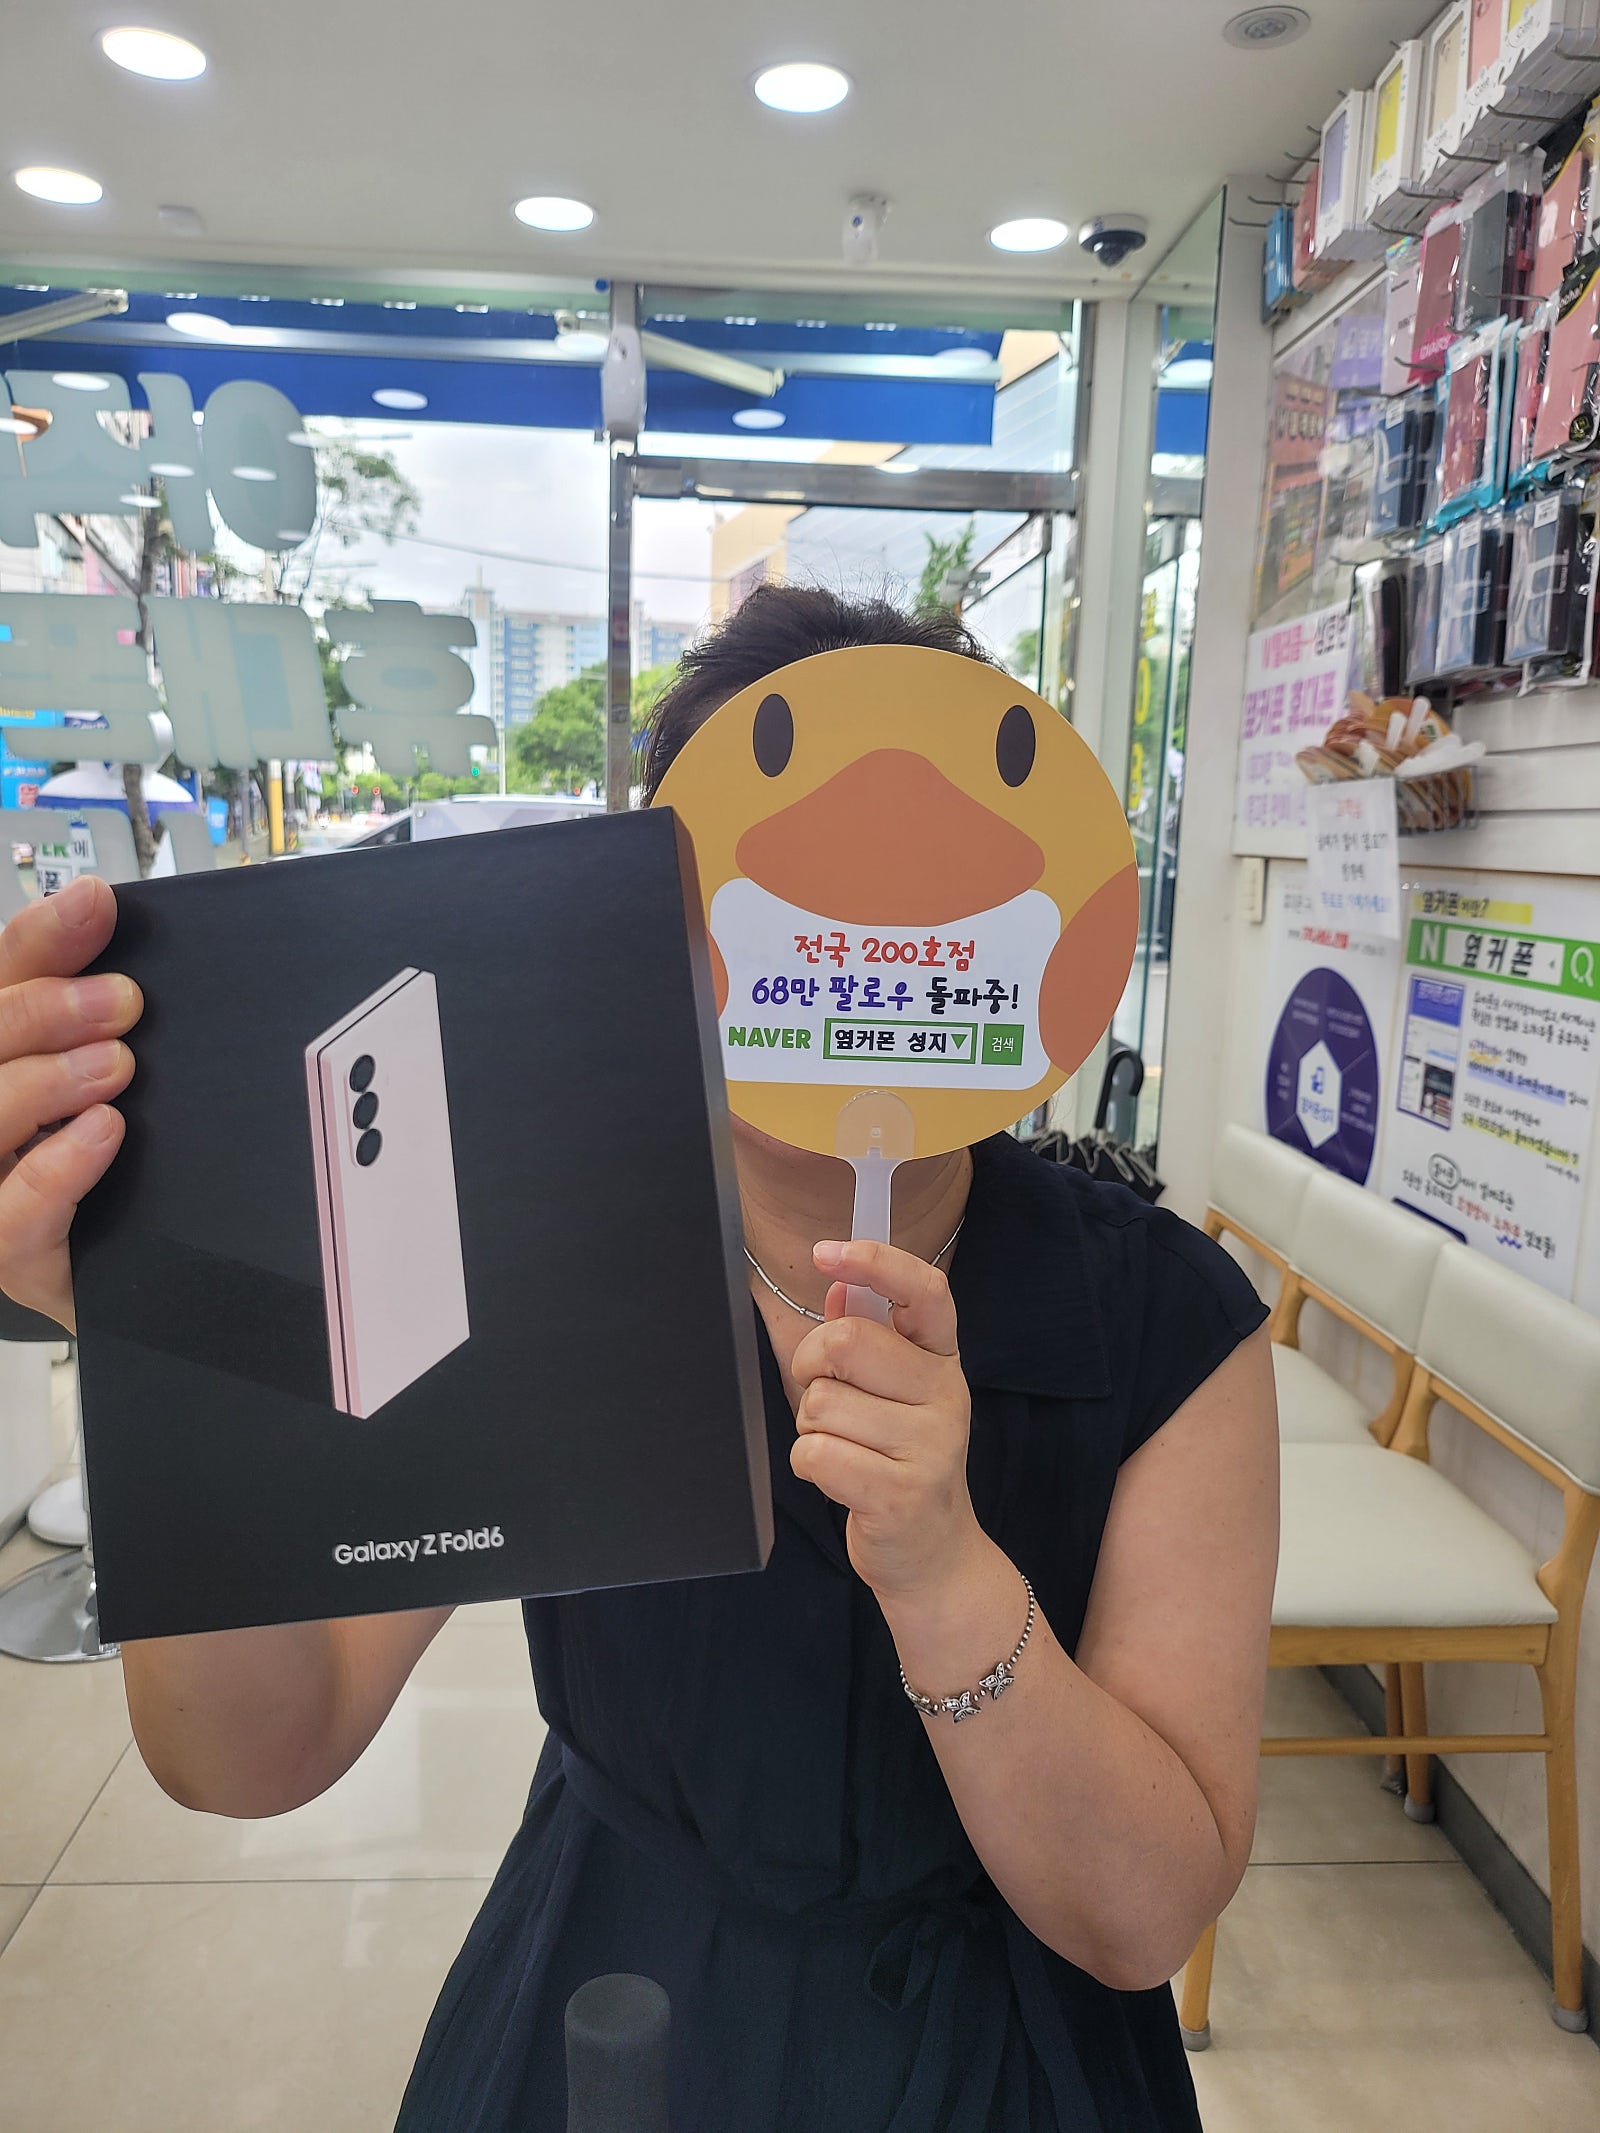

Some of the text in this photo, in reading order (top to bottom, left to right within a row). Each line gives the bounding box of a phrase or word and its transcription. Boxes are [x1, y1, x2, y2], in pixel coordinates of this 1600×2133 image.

[794, 932, 976, 972] 전국 200호점
[752, 975, 1019, 1014] 68만 팔로우 돌파중!
[728, 1026, 1015, 1053] NAVER 옆커폰 성지 검색
[334, 1526, 505, 1565] Galaxy Z Fold6
